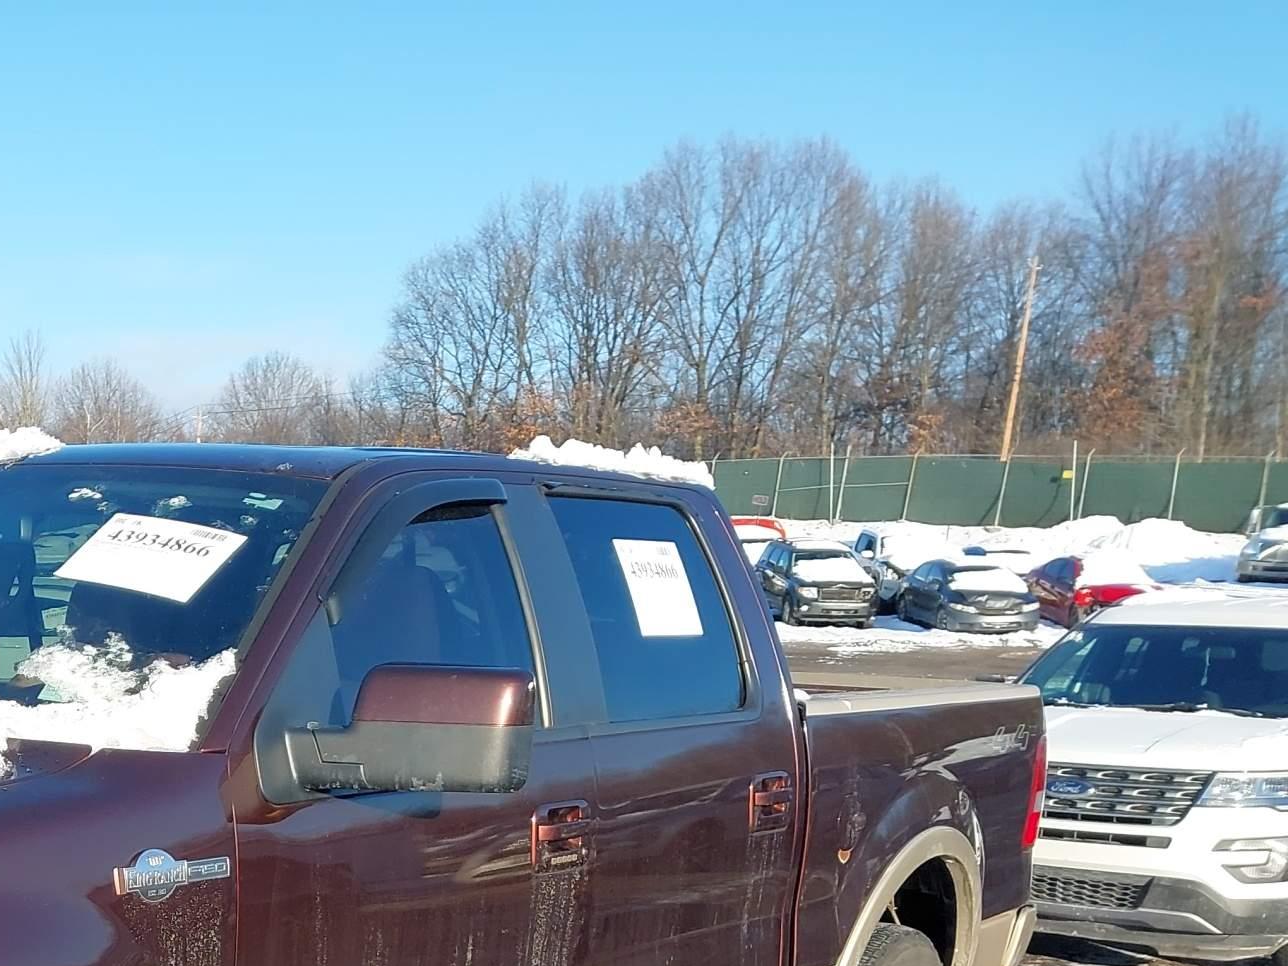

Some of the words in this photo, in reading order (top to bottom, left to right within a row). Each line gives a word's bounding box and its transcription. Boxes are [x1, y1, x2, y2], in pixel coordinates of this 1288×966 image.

[107, 528, 215, 557] 43934866
[1050, 781, 1082, 793] Ford
[128, 869, 153, 889] KING
[153, 864, 187, 885] RANCH
